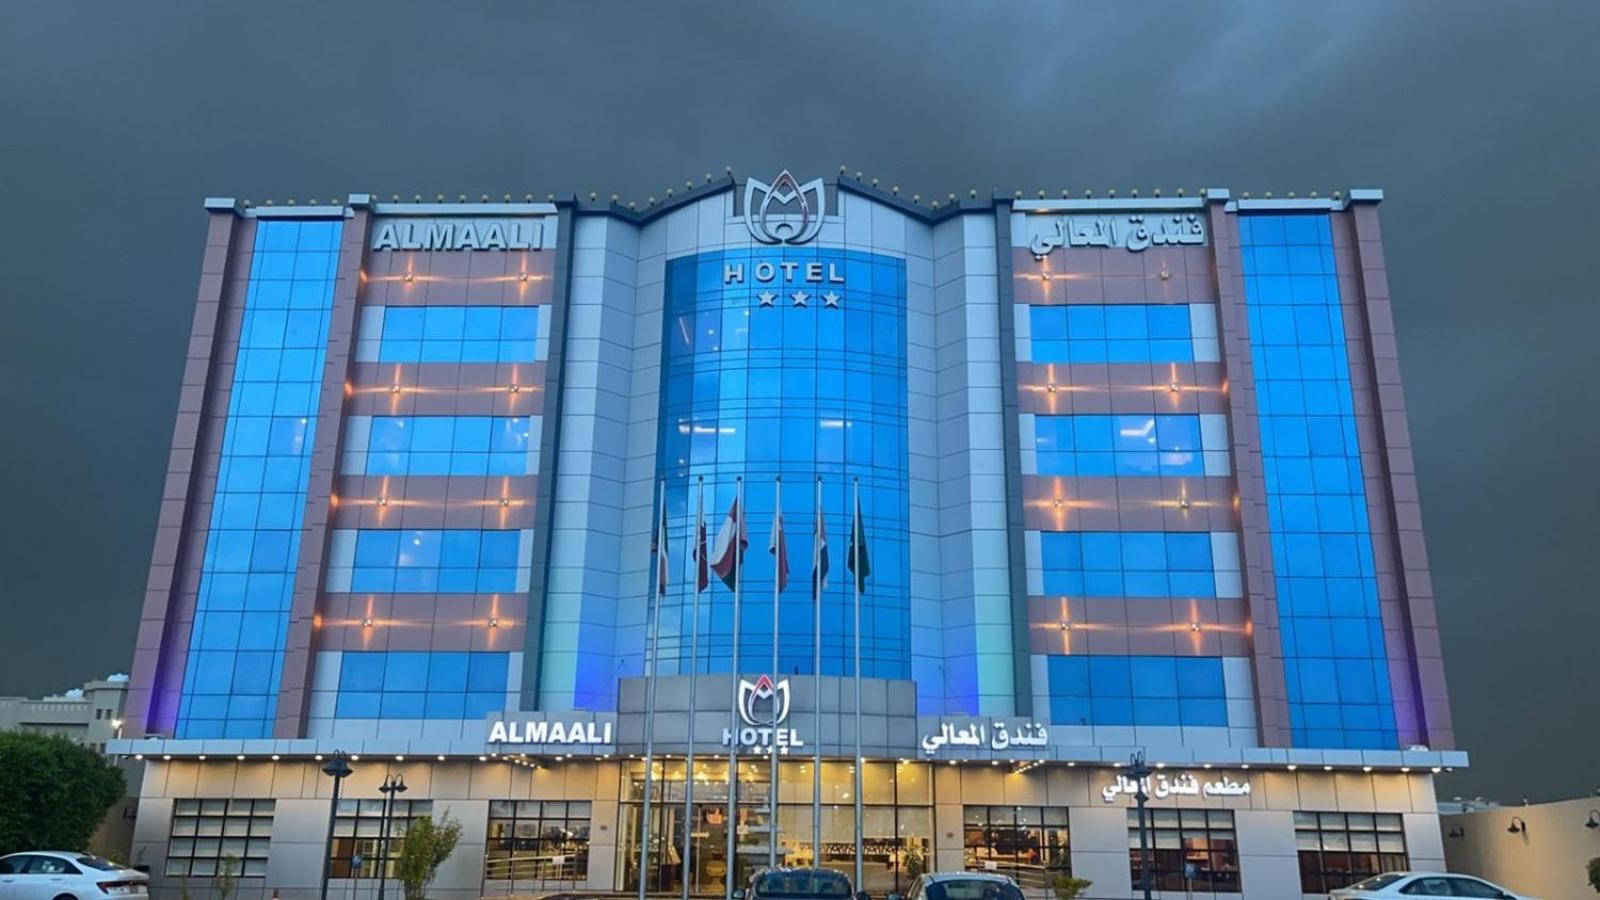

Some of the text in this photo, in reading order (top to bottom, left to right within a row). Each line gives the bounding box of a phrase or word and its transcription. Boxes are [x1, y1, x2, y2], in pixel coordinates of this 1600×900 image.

[373, 222, 543, 250] ALMAALI
[1030, 214, 1205, 262] فندق المعالي
[723, 261, 846, 284] HOTEL
[488, 721, 612, 744] ALMAALI
[722, 728, 804, 747] HOTEL
[922, 721, 1048, 755] فندق المعالي
[1155, 773, 1200, 798] فندق
[1203, 776, 1252, 799] مطعم
